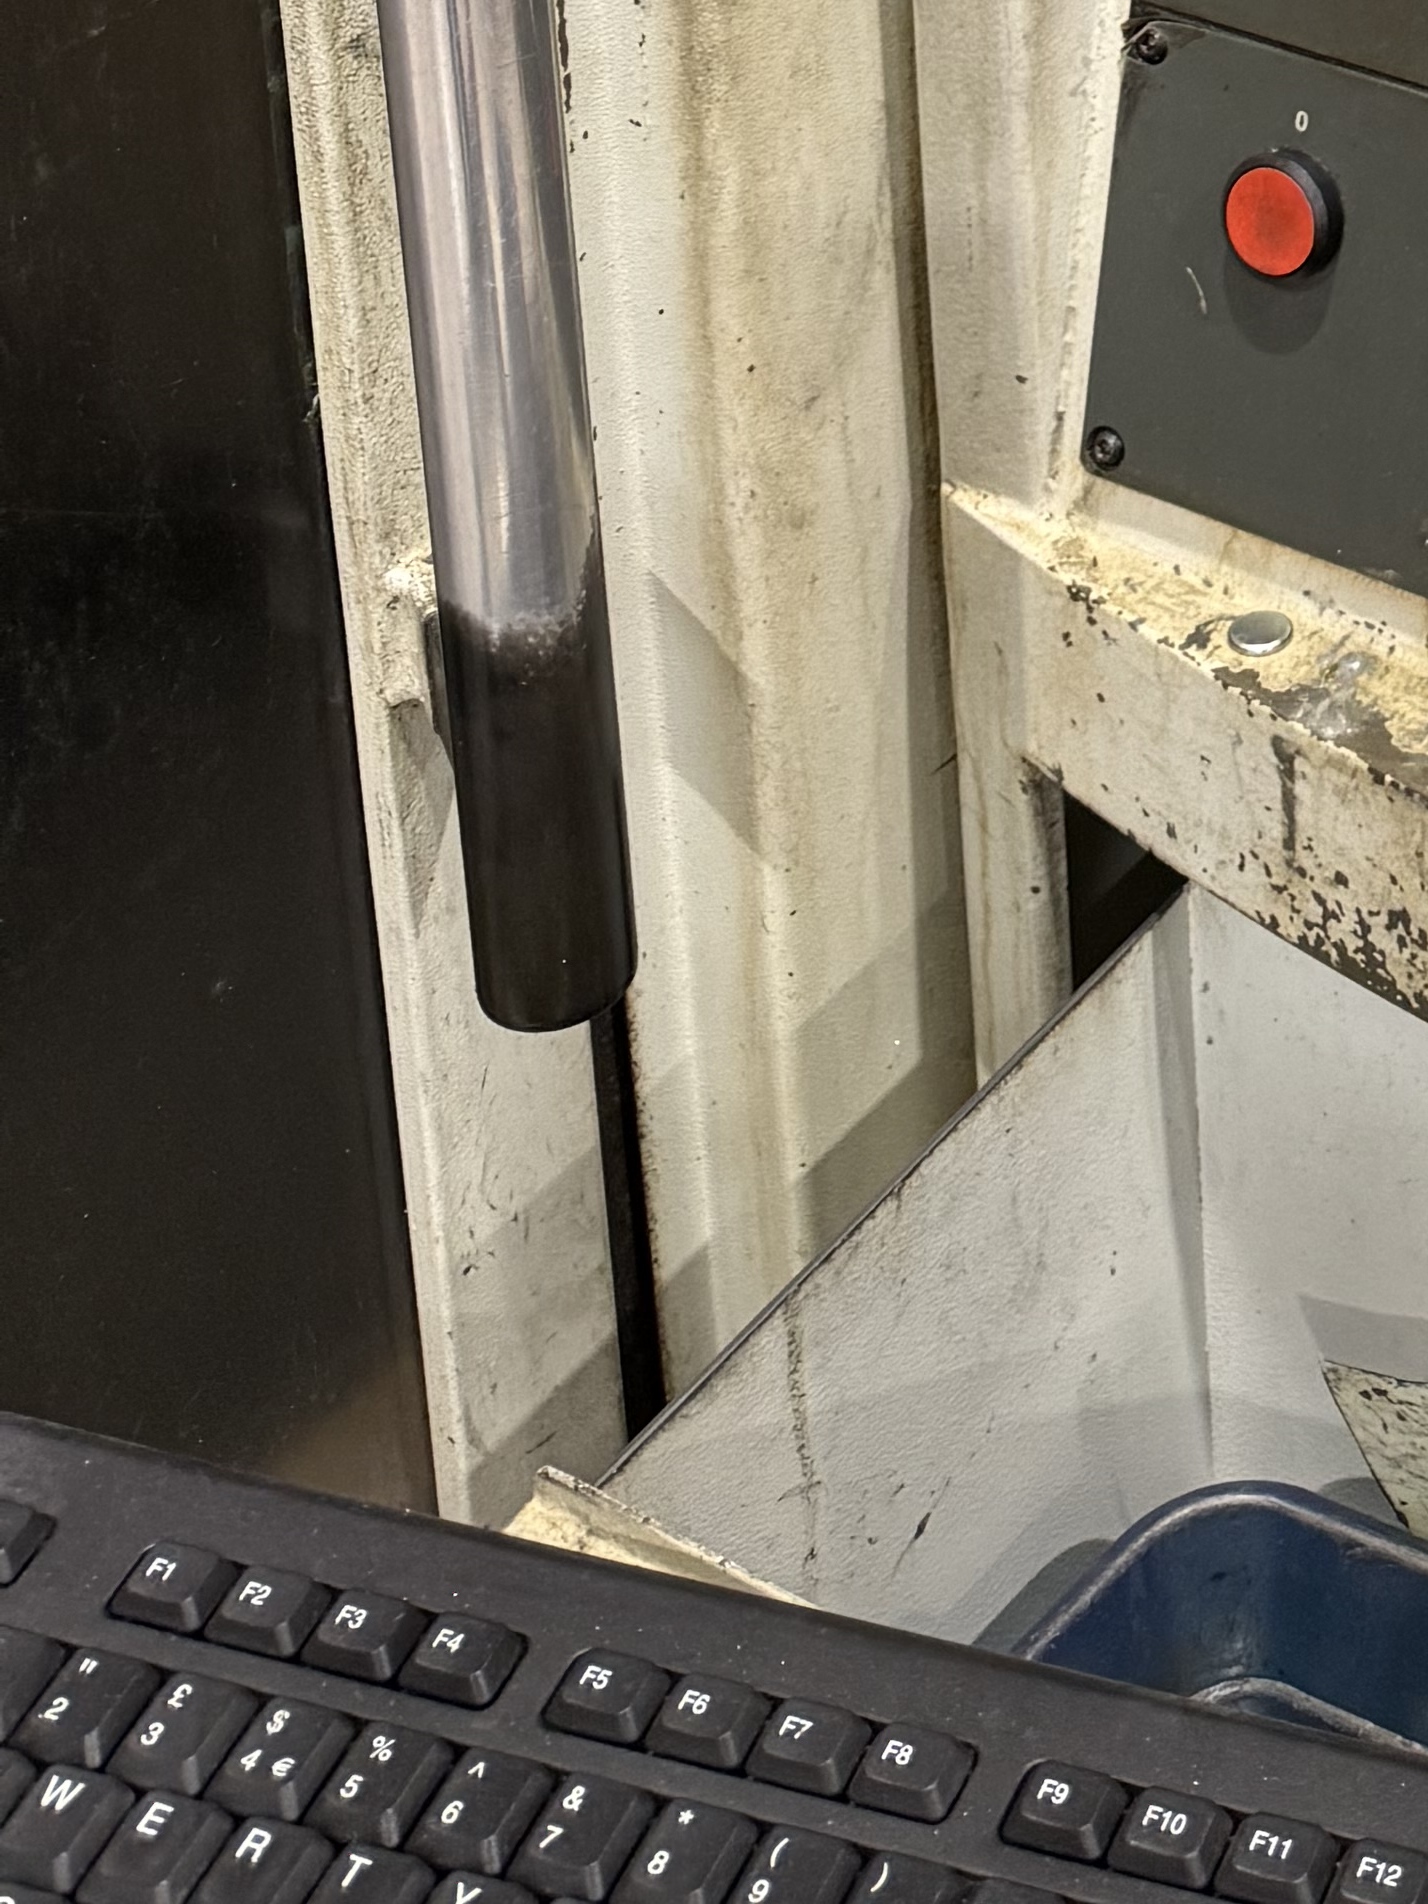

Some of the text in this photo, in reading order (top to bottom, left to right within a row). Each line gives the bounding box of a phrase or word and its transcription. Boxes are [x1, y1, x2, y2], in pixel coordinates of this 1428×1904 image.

[145, 1557, 465, 1654] F1 F2 F3 F4
[1037, 1779, 1404, 1888] F9 F10 F11 F12
